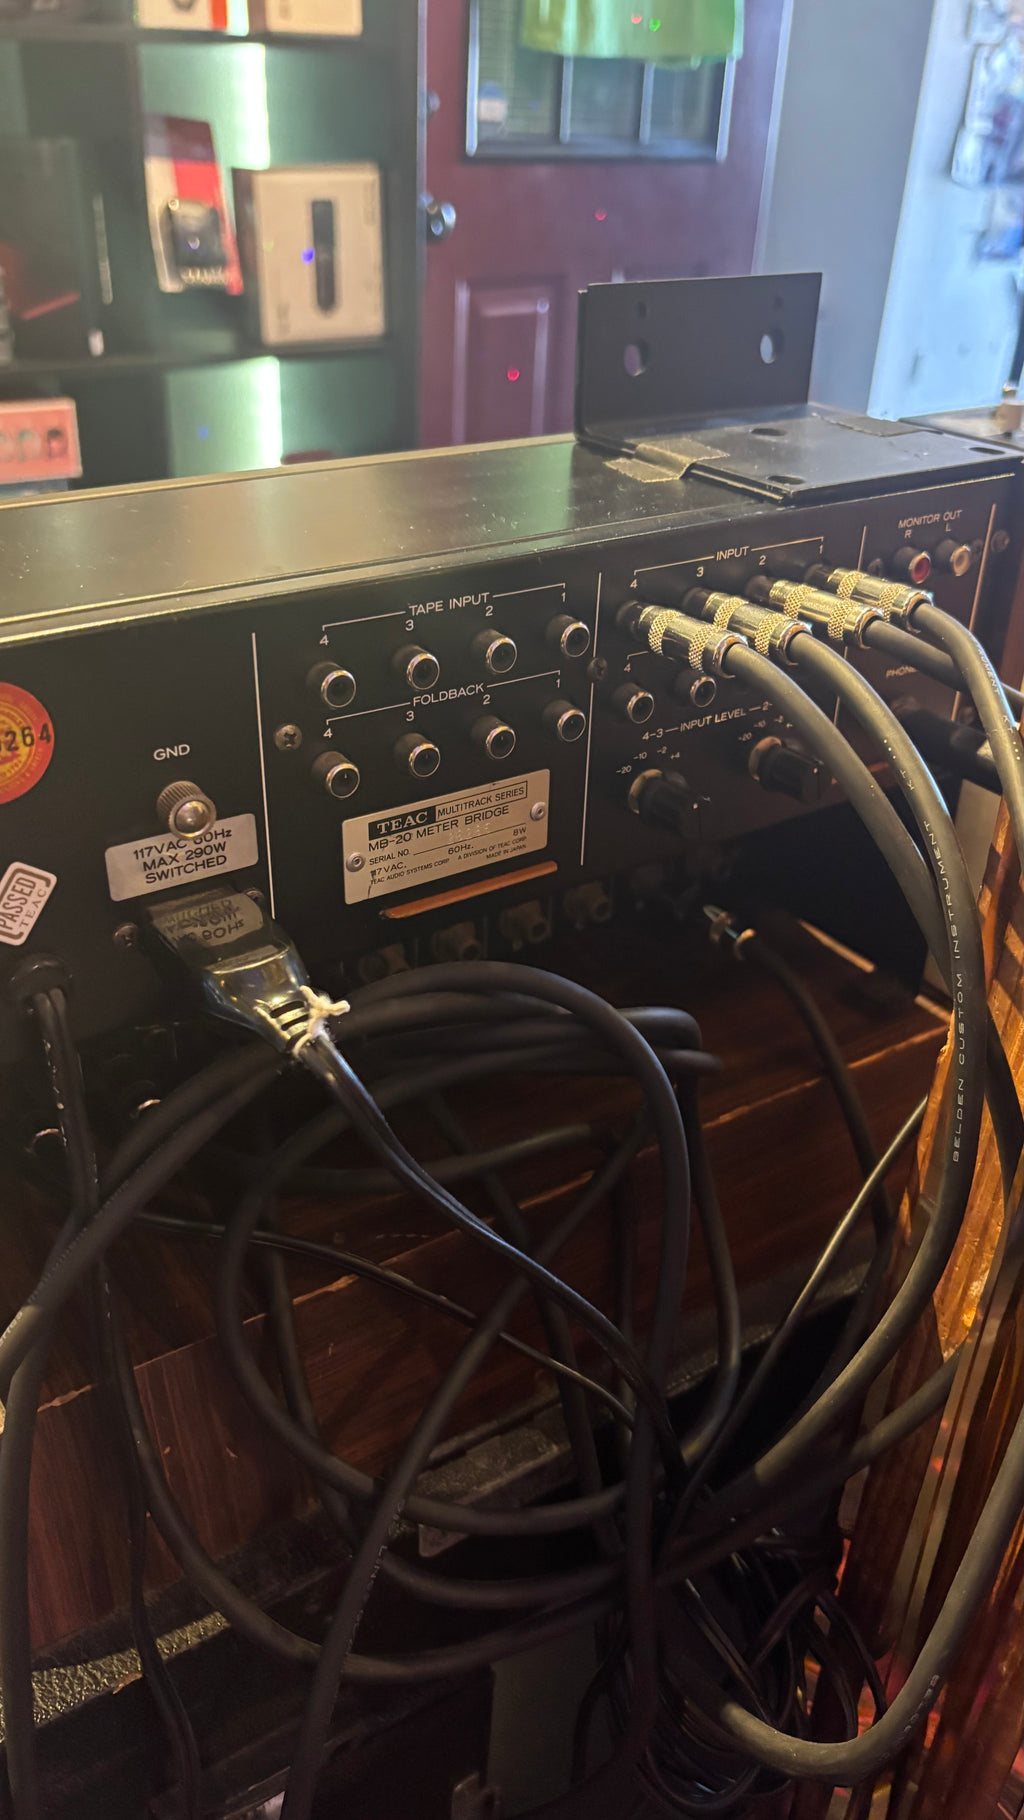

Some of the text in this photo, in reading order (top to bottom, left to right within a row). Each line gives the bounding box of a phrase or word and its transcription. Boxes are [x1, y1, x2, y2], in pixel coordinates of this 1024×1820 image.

[898, 509, 963, 529] MONITOR OUT
[904, 523, 952, 538] R L
[716, 546, 750, 561] INPUT
[629, 578, 638, 589] 4
[696, 566, 704, 577] 3
[758, 555, 767, 566] 2
[408, 592, 491, 617] TAPE INPUT
[319, 634, 330, 646] 4
[405, 619, 414, 631] 3
[485, 605, 494, 617] 2
[412, 682, 486, 708] FOLDBACK
[323, 727, 333, 739] 4
[406, 710, 415, 722] 3
[483, 694, 491, 706] 2
[680, 715, 713, 732] INPUT
[714, 708, 747, 723] LEVEL
[0, 723, 51, 752] 264
[153, 744, 190, 761] GND
[616, 765, 632, 775] -20
[376, 811, 428, 834] TEAC
[437, 795, 493, 818] MULTITRACK
[494, 787, 525, 802] SERIES
[368, 832, 412, 852] MB-20
[416, 819, 459, 839] METER
[464, 805, 510, 826] BRIDGE
[512, 826, 527, 836] 8W
[143, 841, 227, 872] MAX 290W
[145, 855, 227, 884] SWITCHED
[369, 853, 396, 866] SERIAL
[386, 871, 405, 881] AUDIO
[406, 862, 433, 876] SYSTEMS
[0, 877, 36, 931] PASSED
[923, 820, 962, 959] INSTRUMENT
[19, 889, 47, 927] TEAC
[956, 974, 966, 1065] CUSTOM
[952, 1078, 965, 1162] BELDEN
